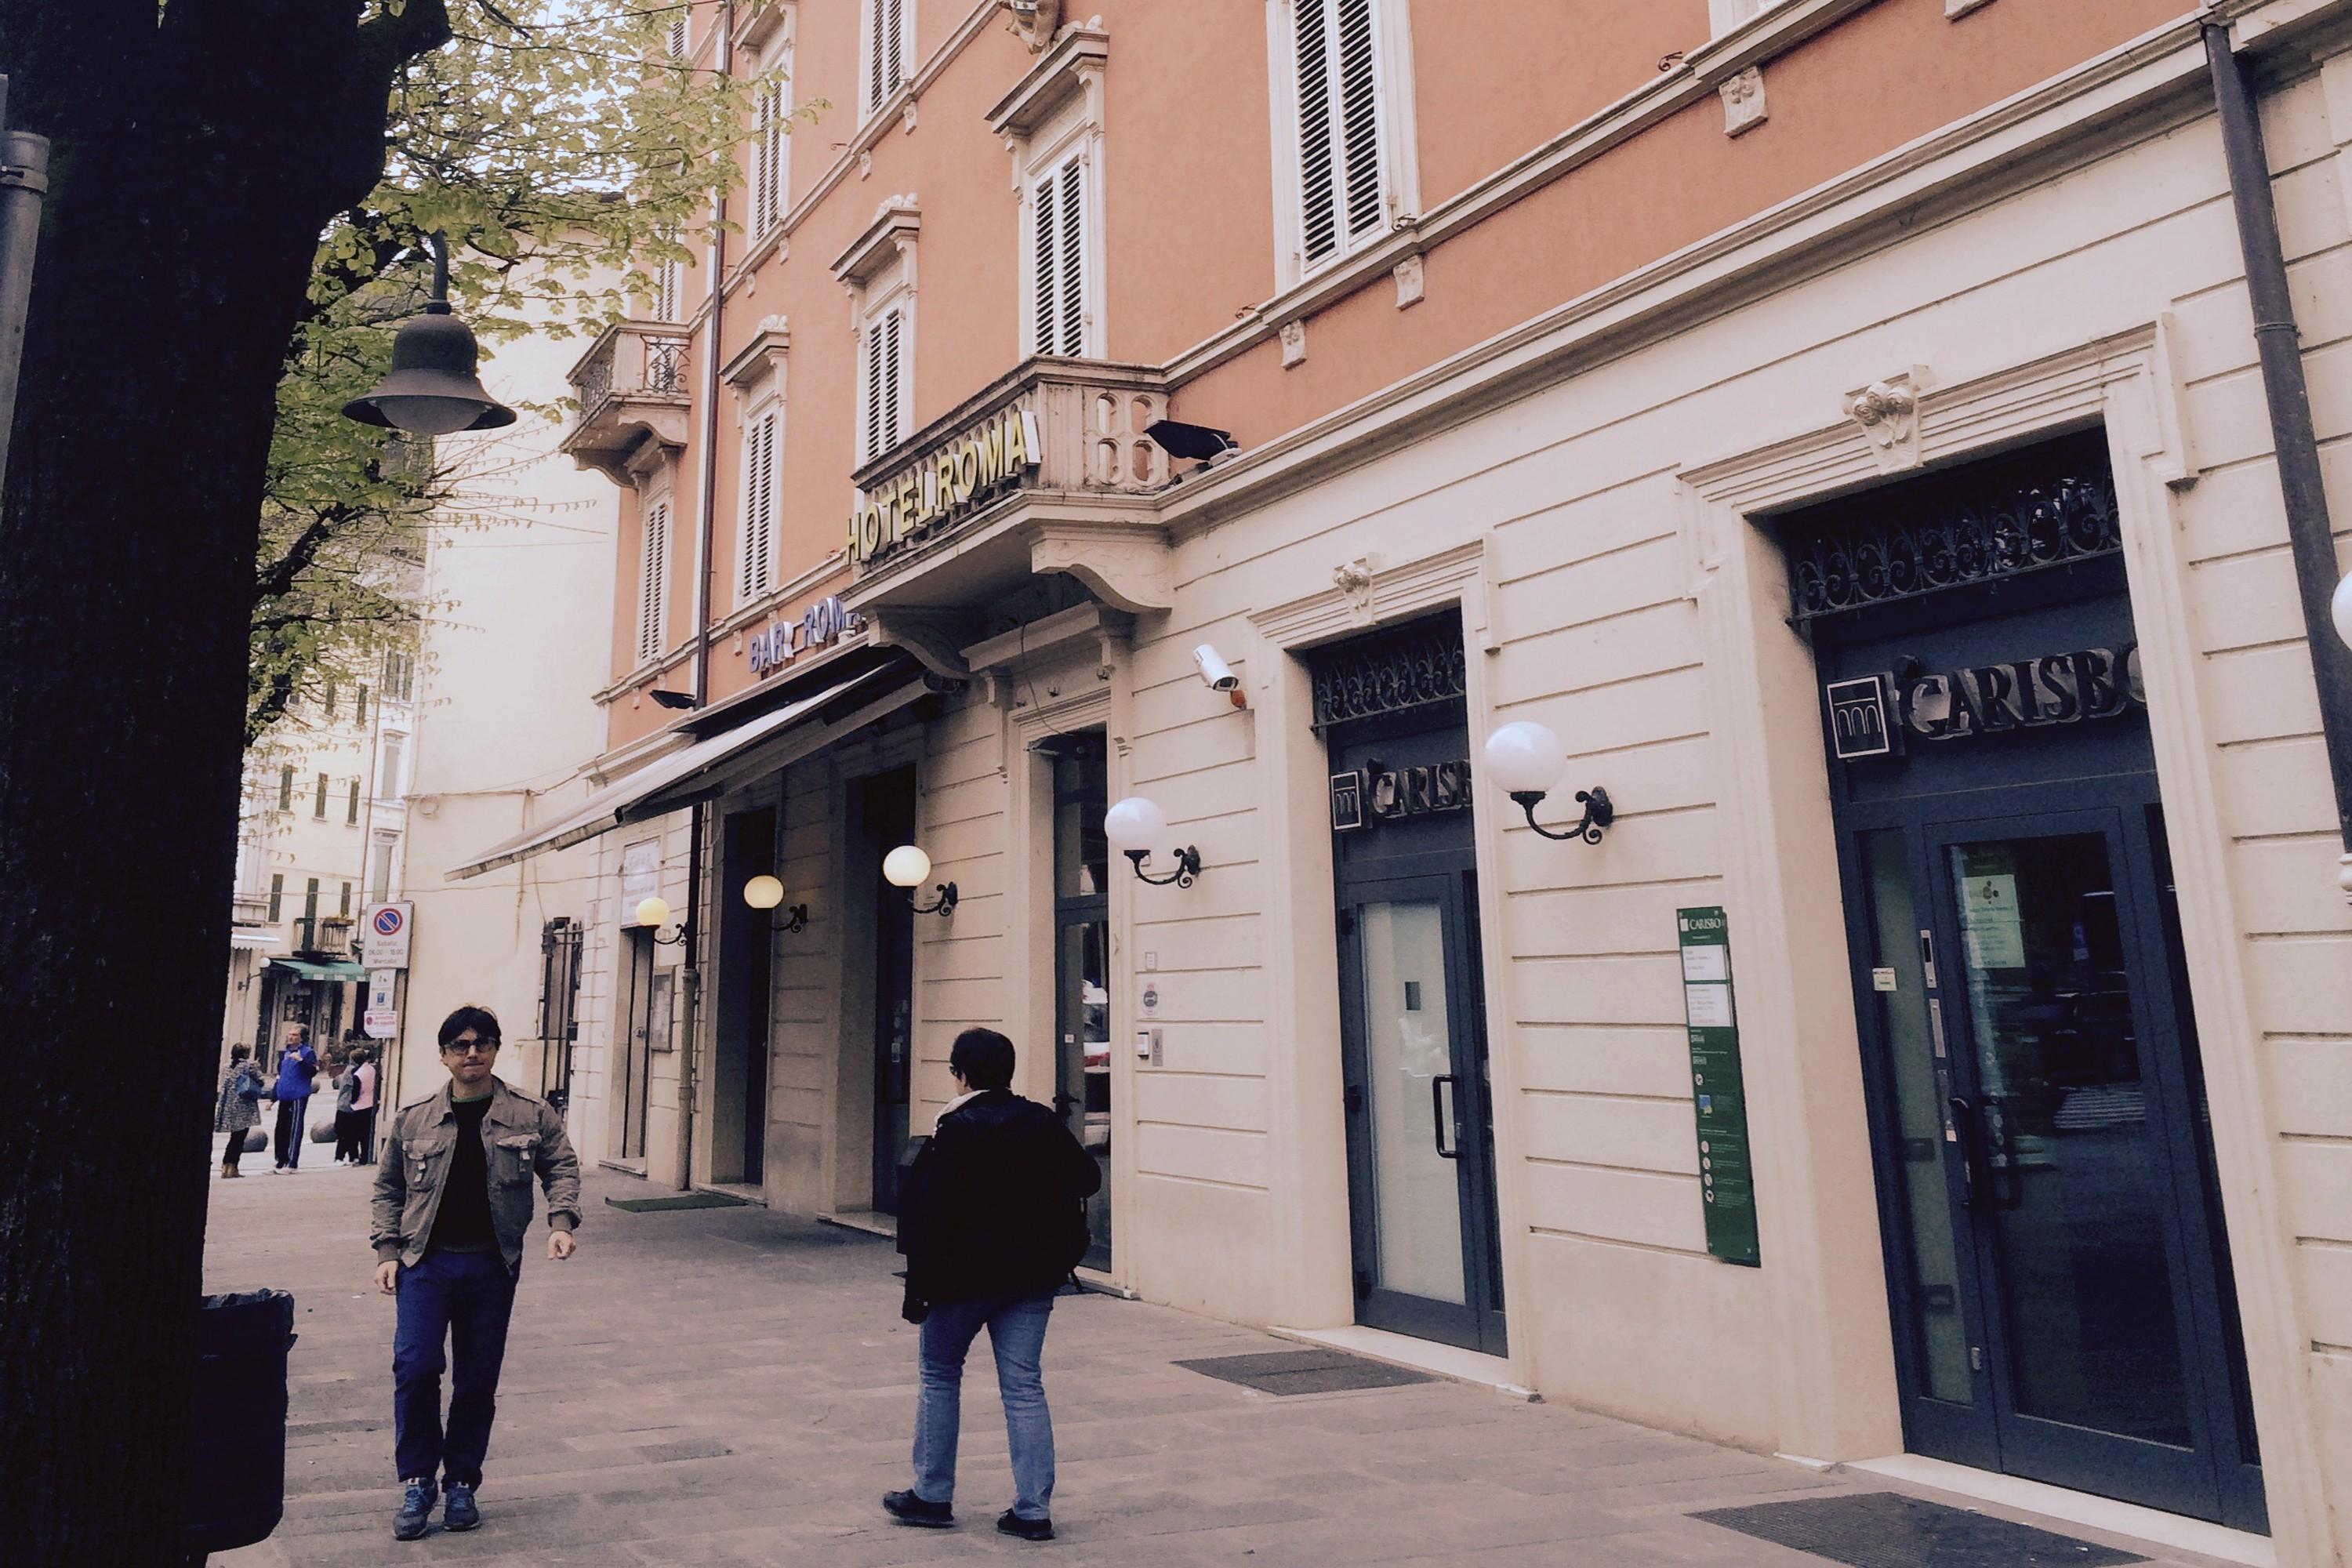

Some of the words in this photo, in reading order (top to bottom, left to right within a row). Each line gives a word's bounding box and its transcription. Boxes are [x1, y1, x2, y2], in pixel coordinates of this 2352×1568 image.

[845, 470, 937, 565] HOTEL
[937, 410, 1040, 511] ROMA
[750, 622, 792, 673] BAR
